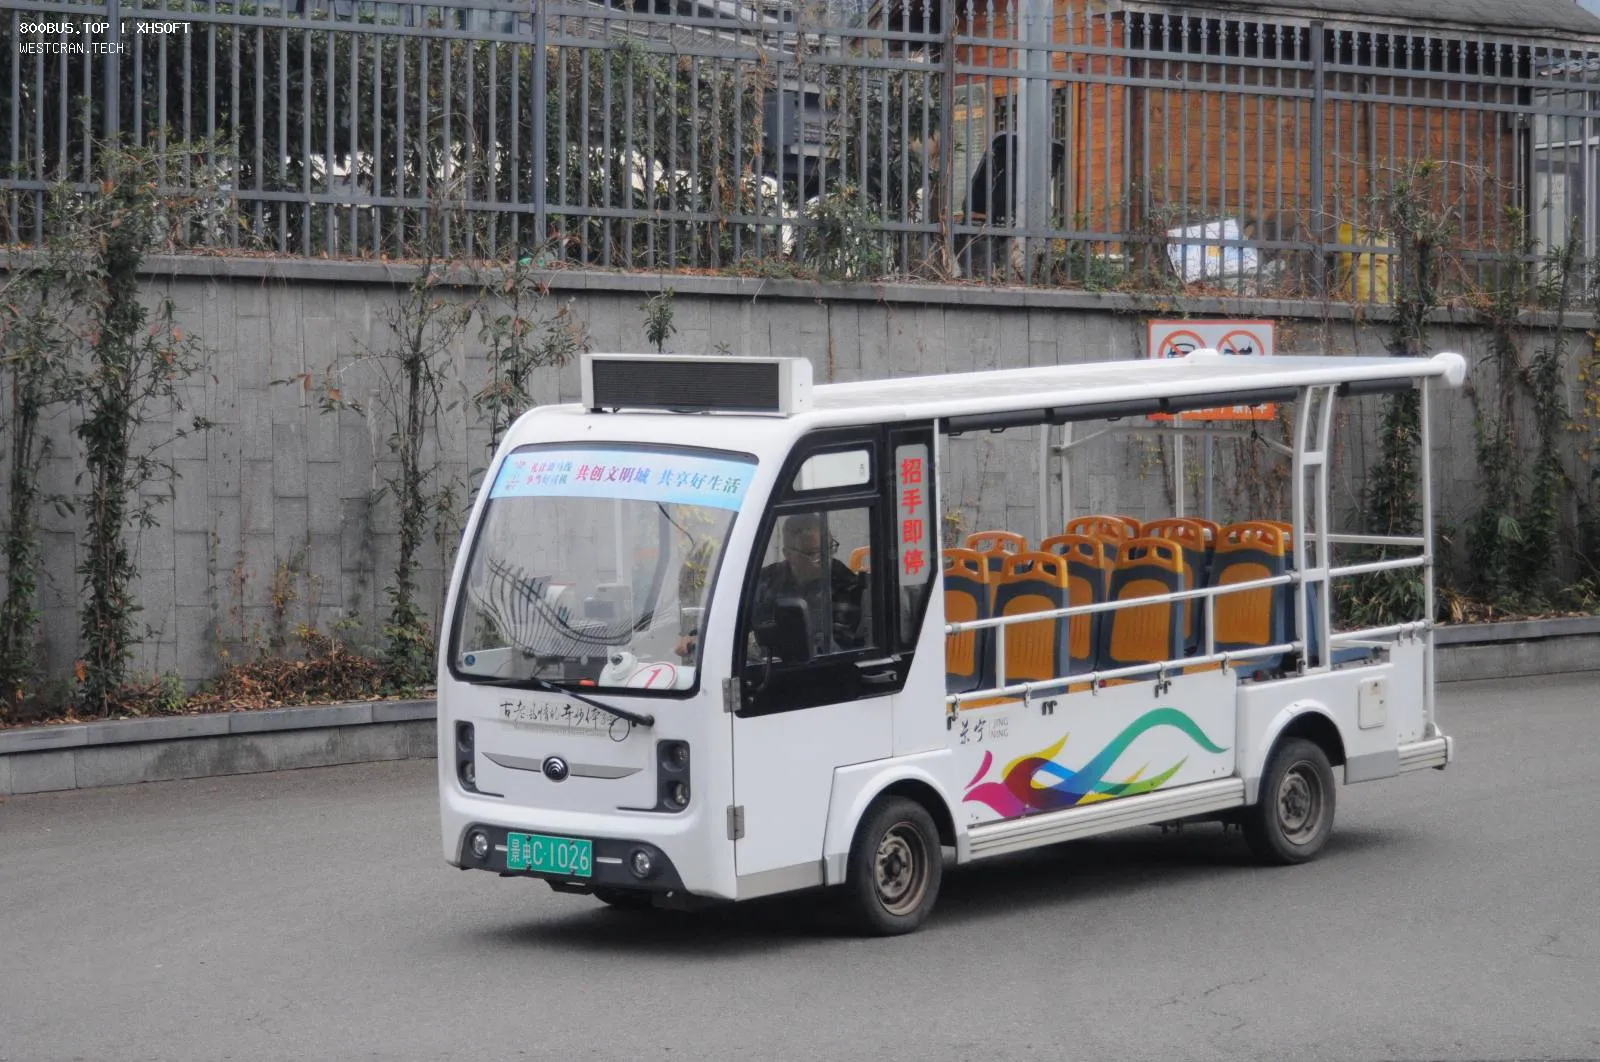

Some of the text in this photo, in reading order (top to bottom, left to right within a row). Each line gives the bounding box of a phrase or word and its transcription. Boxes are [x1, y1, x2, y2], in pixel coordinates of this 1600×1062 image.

[575, 463, 742, 494] 共创文明城 共享好生活
[901, 458, 925, 575] 招手即停
